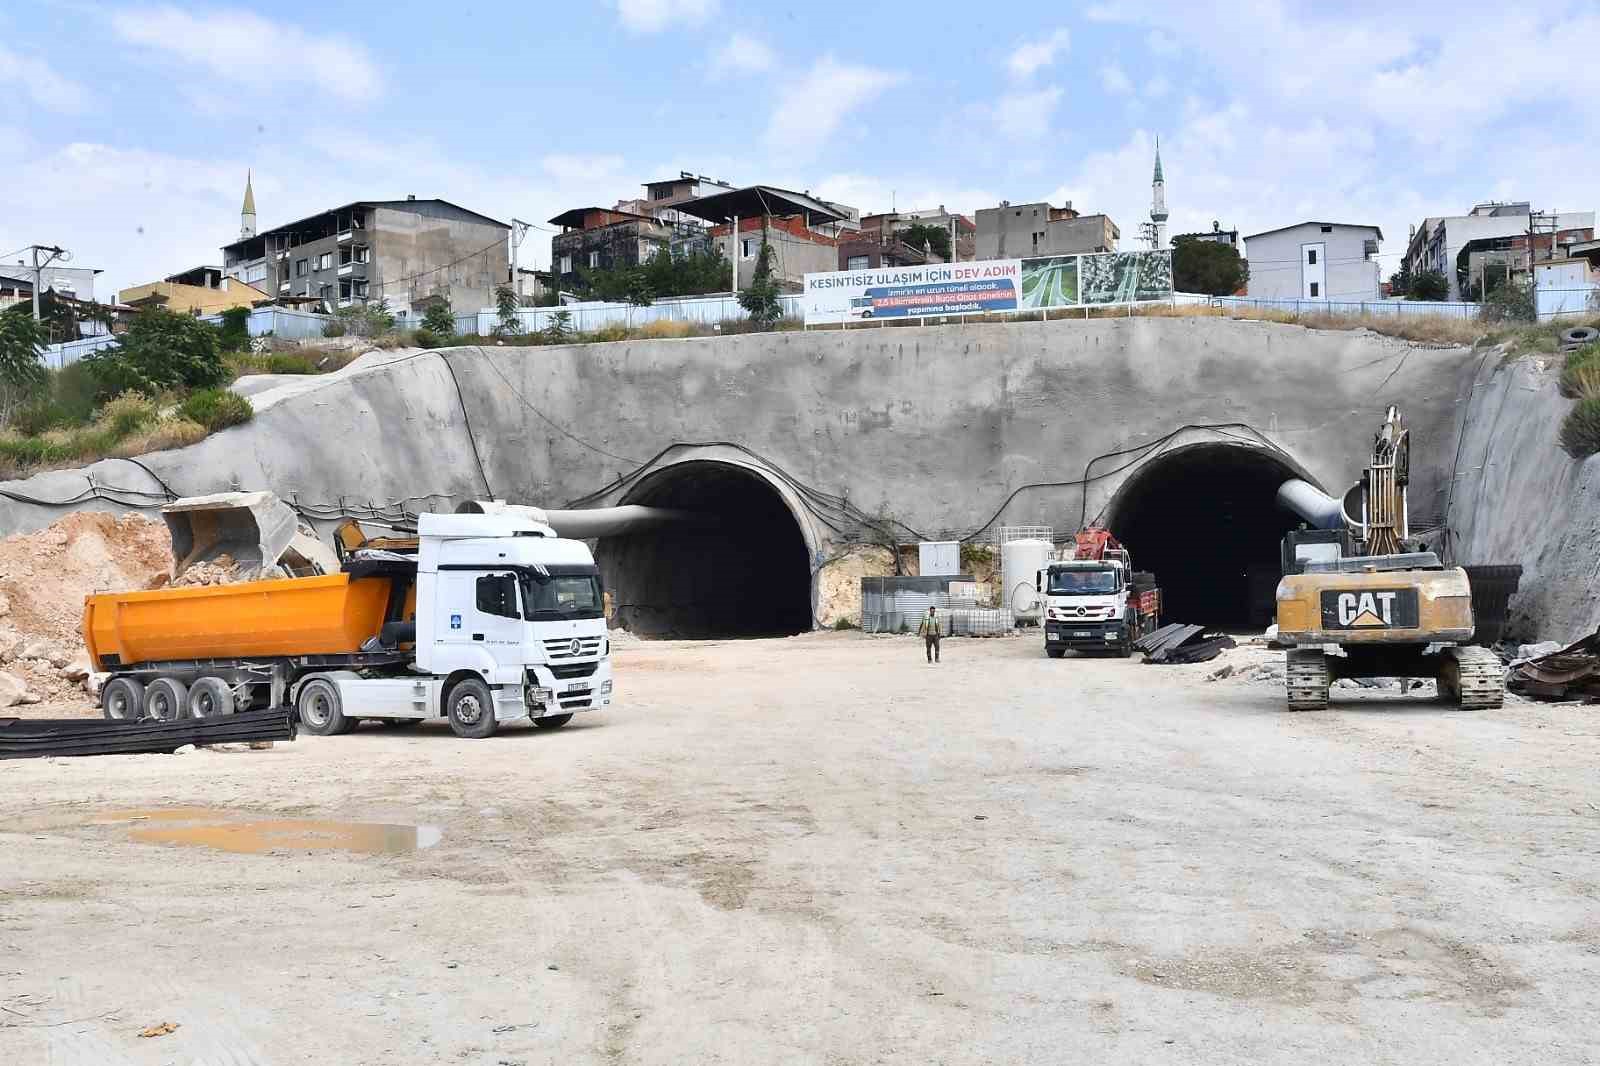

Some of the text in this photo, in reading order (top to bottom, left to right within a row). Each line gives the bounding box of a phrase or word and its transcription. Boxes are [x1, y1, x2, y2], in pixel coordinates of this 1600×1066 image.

[810, 264, 1016, 289] KESİNTİSİZ ULAŞIM İÇİN DEV ADIM
[978, 291, 1012, 300] tüninin
[1338, 592, 1396, 626] CAT
